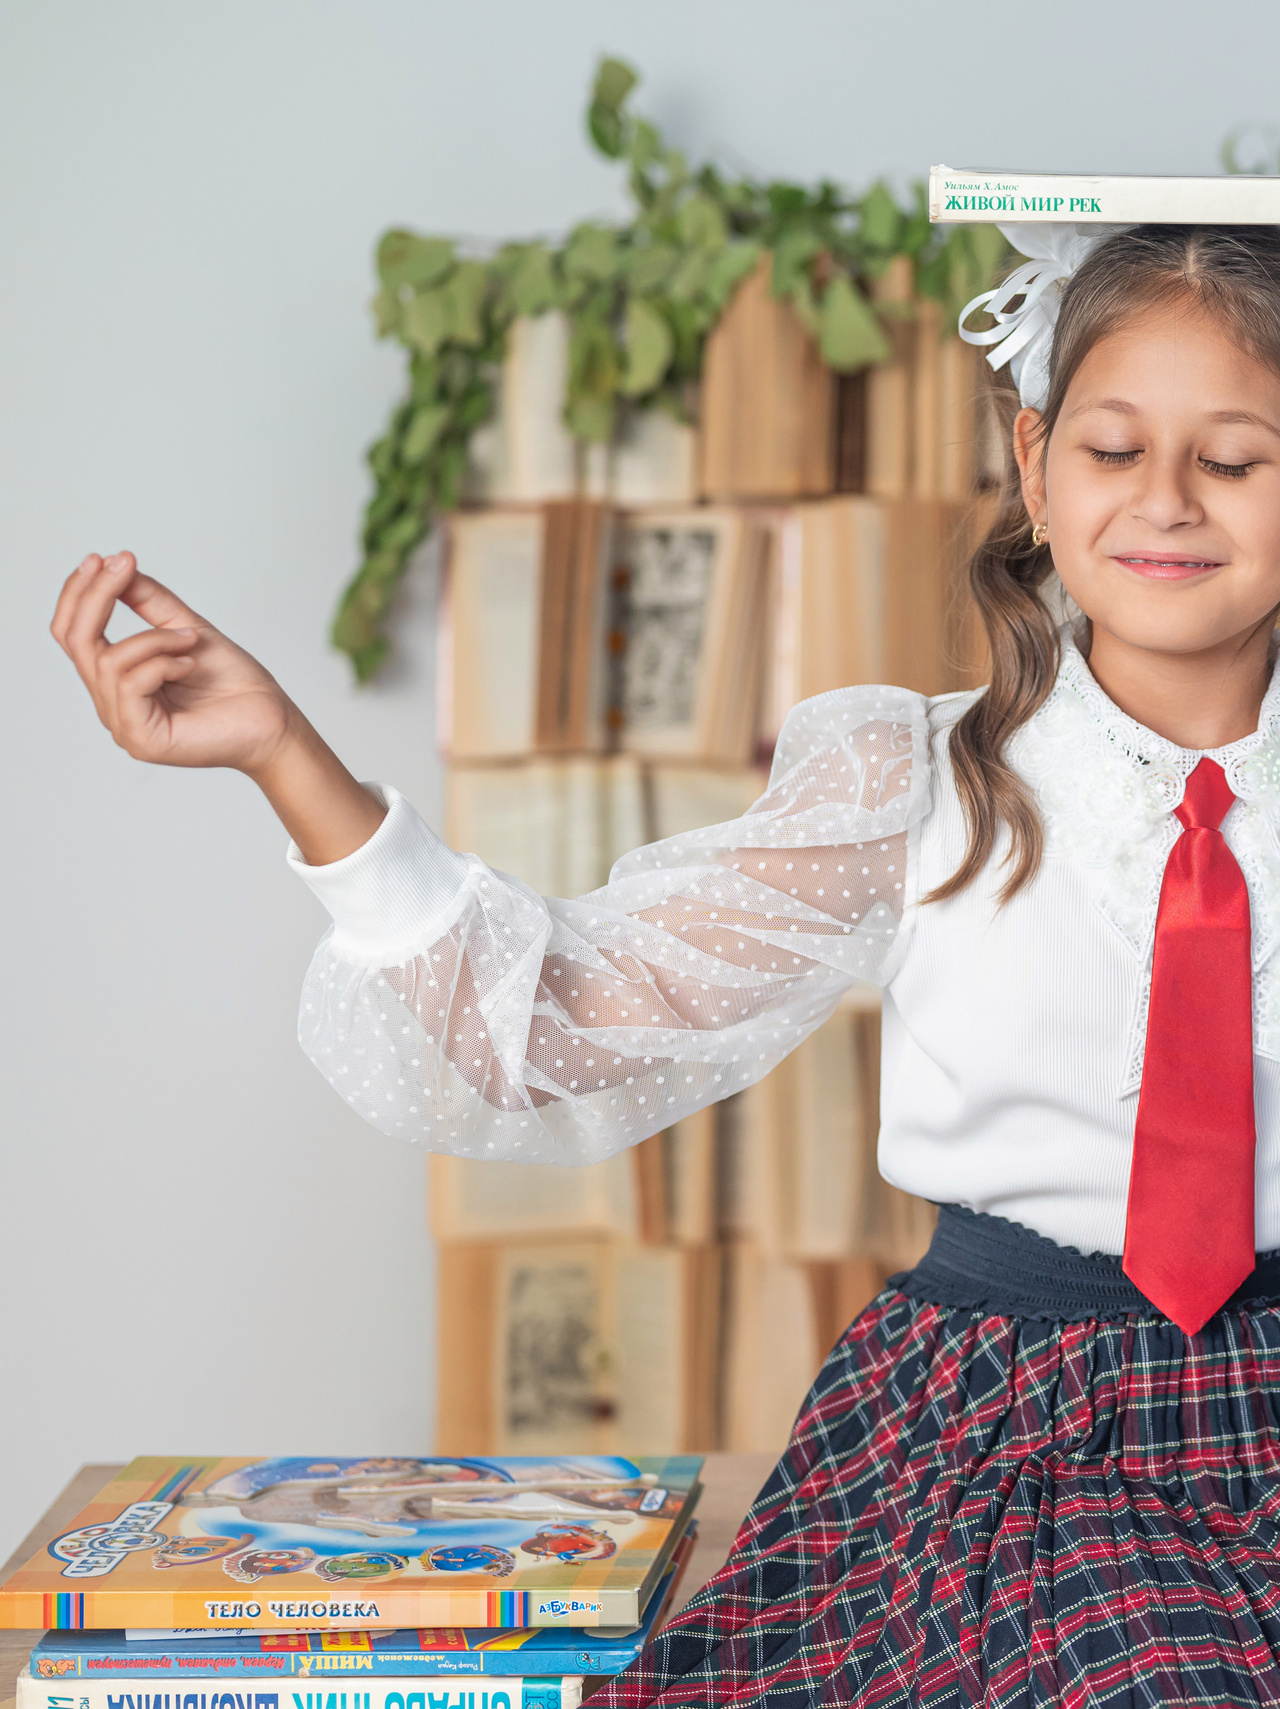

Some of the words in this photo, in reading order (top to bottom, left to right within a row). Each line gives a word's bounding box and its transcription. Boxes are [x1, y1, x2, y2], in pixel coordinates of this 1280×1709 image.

[944, 181, 981, 191] Уильям
[994, 182, 1019, 191] Амос
[945, 194, 1016, 211] ЖИВОЙ
[1020, 197, 1064, 212] МИР
[1069, 198, 1102, 213] РЕК
[206, 1602, 262, 1618] ТЕЛО
[270, 1602, 381, 1618] ЧЕЛОВЕКА
[87, 1655, 173, 1671] путешествуем
[175, 1656, 238, 1672] отдыхаем,
[240, 1655, 286, 1670] Играем,
[299, 1655, 373, 1670] МИША
[377, 1655, 446, 1663] медвежонок
